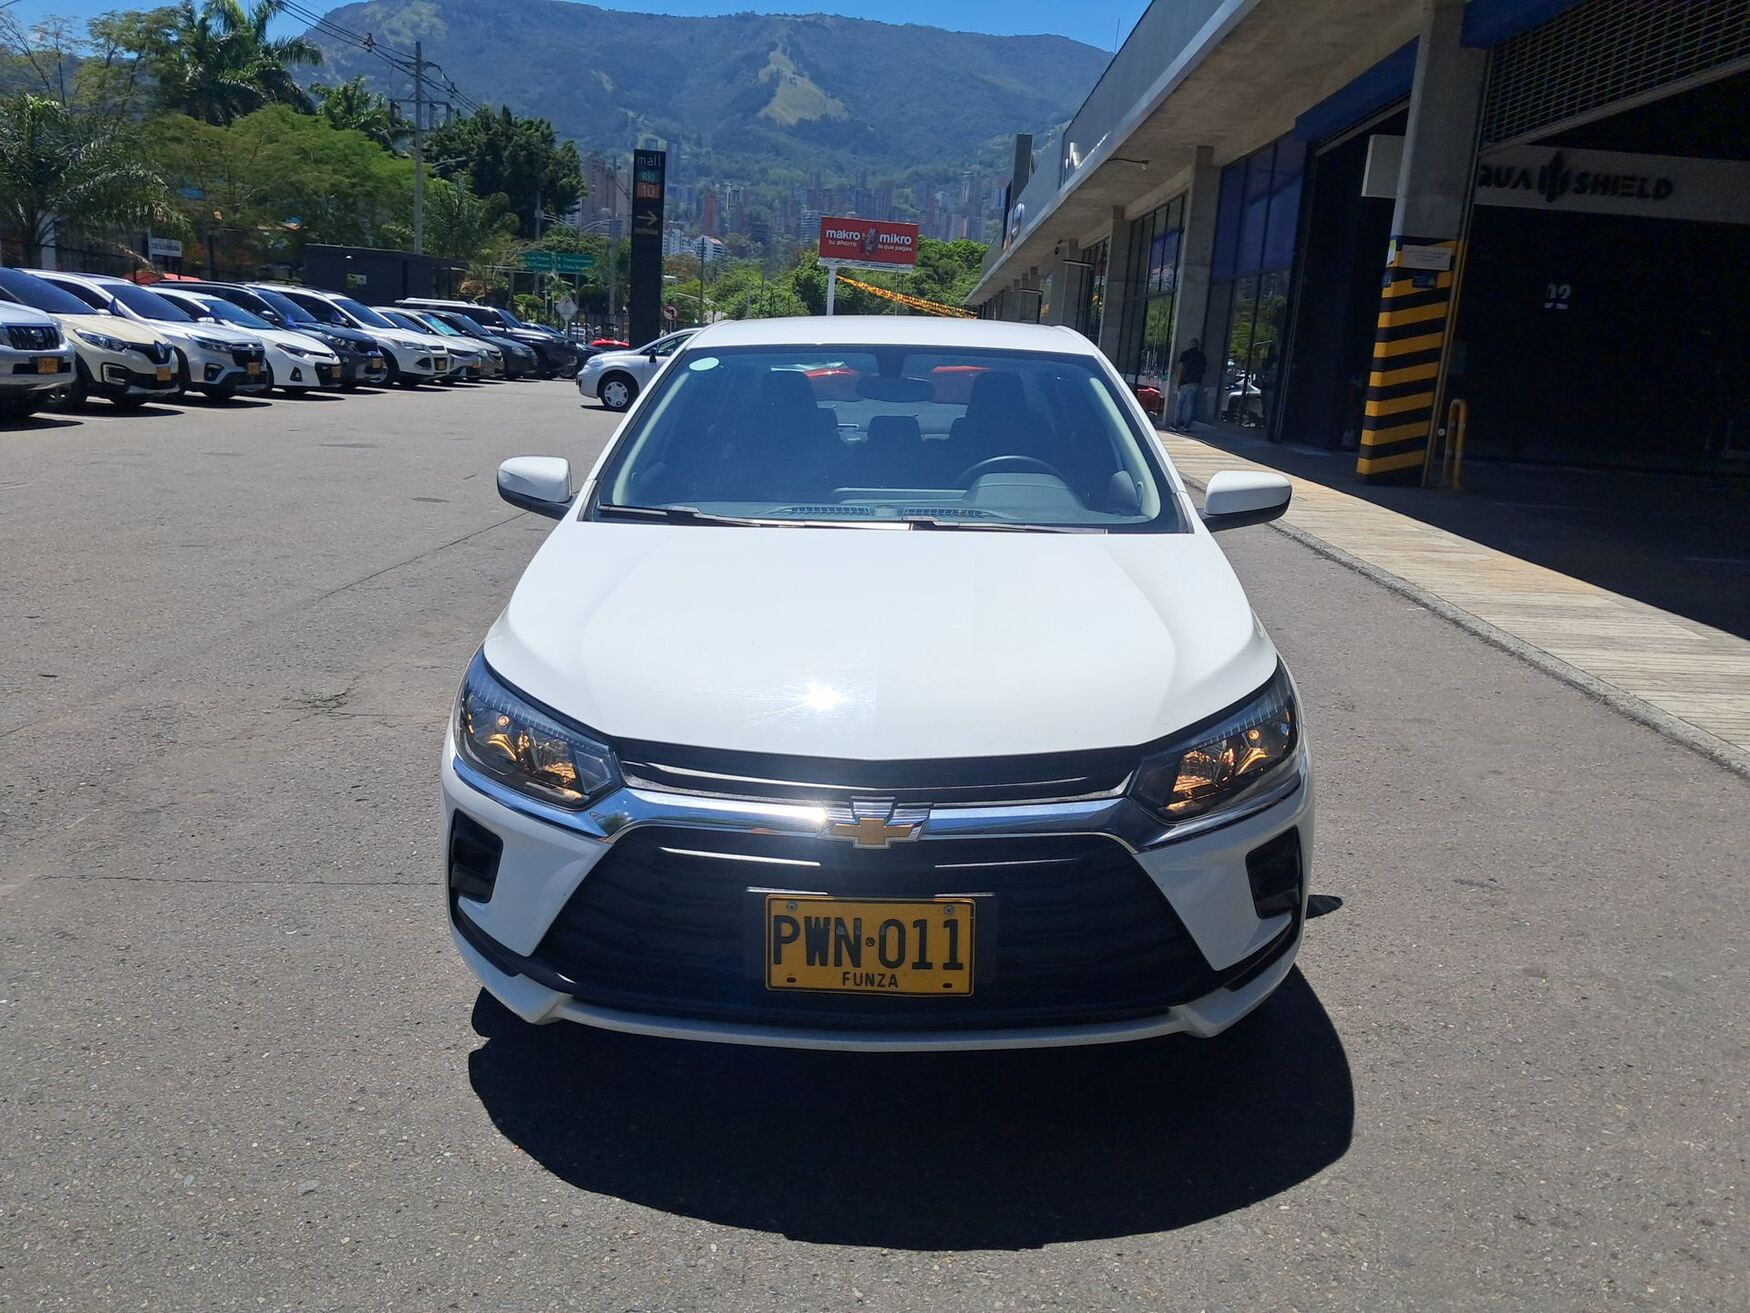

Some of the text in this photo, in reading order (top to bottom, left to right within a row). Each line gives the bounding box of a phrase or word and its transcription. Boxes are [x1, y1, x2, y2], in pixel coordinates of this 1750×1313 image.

[637, 154, 661, 167] mall
[1573, 171, 1673, 200] SHIELD
[826, 229, 861, 241] makro
[879, 233, 912, 245] mikro
[895, 245, 912, 253] pagas
[842, 971, 899, 988] FUNZA
